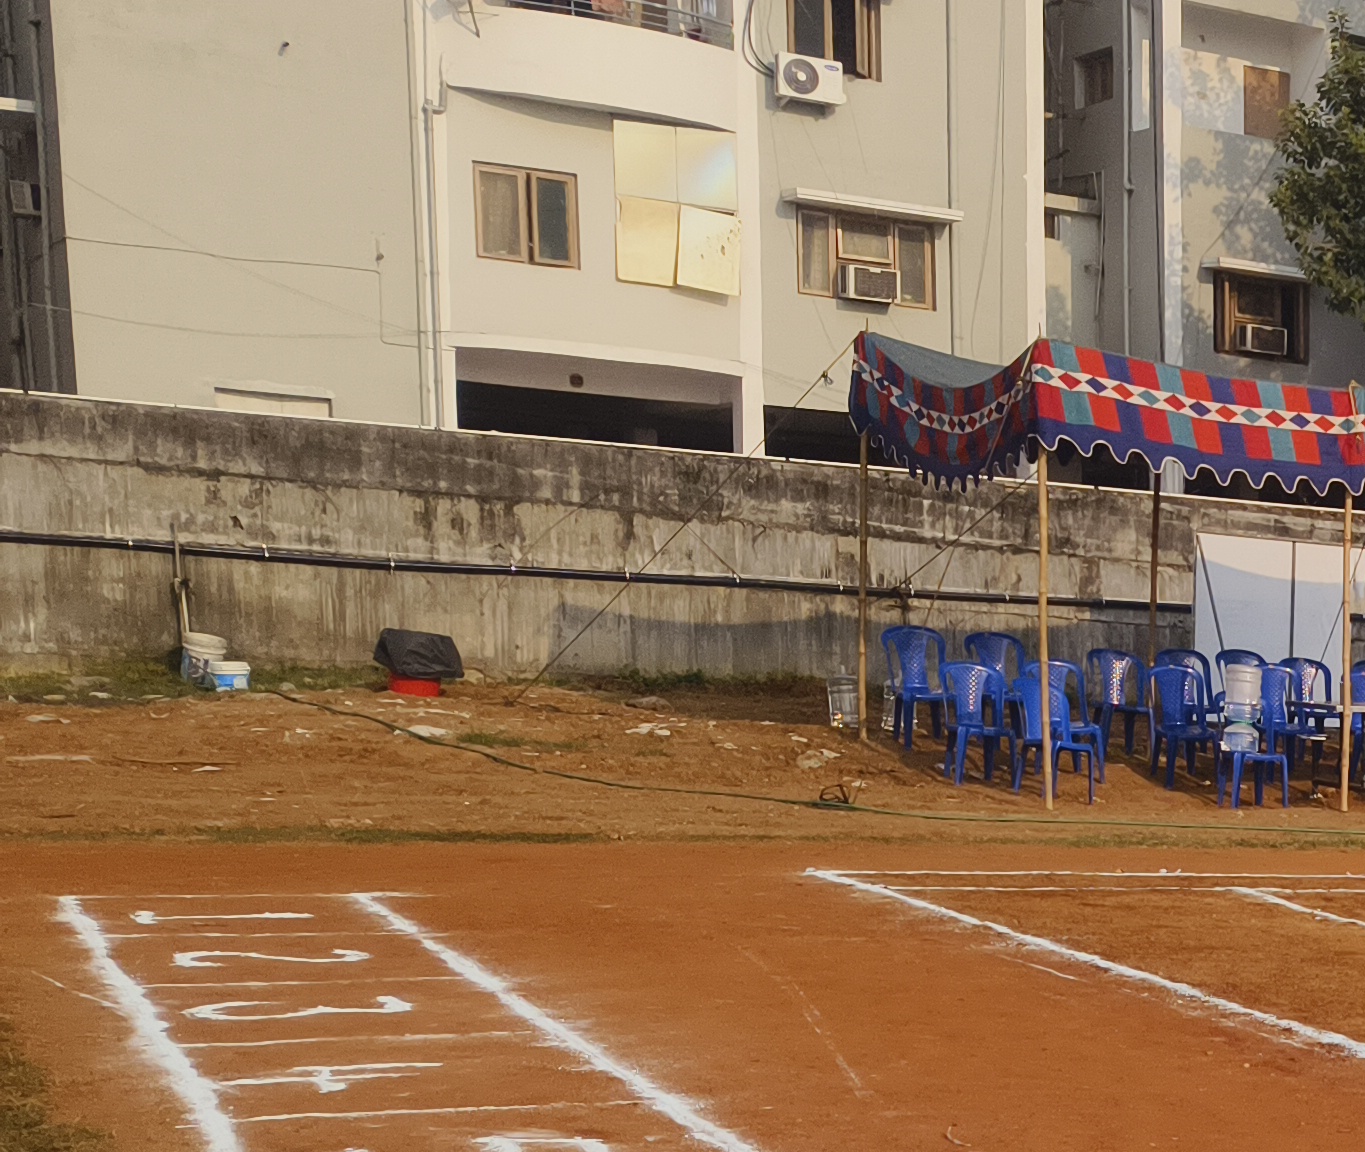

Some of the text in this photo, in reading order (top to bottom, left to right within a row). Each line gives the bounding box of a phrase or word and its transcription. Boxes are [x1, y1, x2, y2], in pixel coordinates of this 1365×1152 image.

[170, 948, 372, 968] 2
[179, 995, 414, 1021] 3
[218, 1061, 444, 1094] 4
